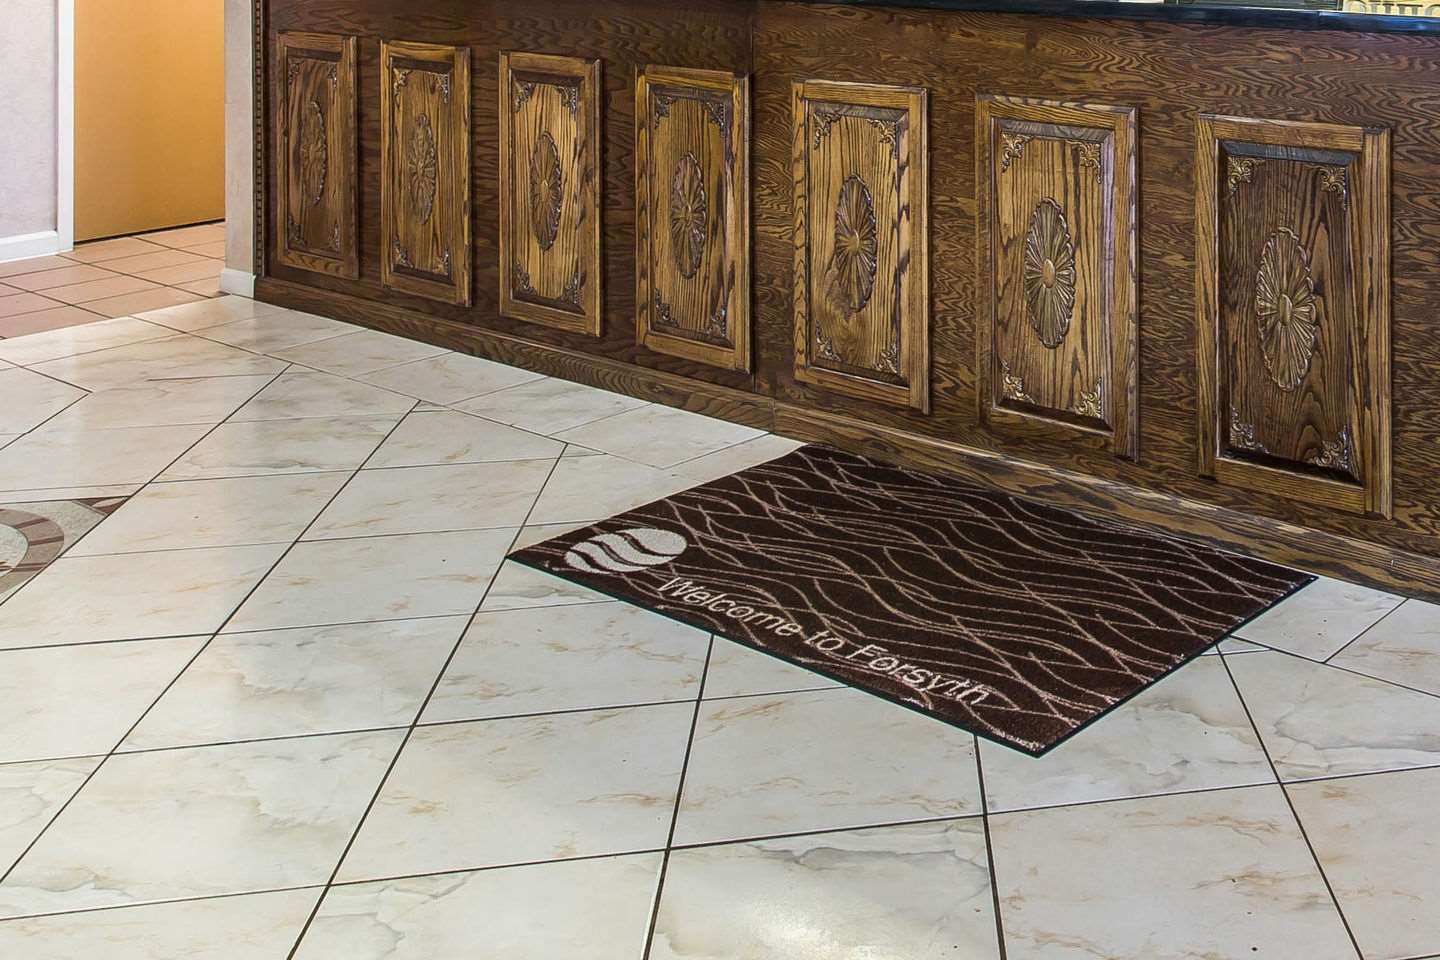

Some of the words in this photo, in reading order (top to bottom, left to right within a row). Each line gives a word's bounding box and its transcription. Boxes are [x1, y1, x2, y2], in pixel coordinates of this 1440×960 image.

[657, 576, 803, 637] Welcome
[804, 629, 845, 652] to
[846, 643, 990, 705] Forsyth
